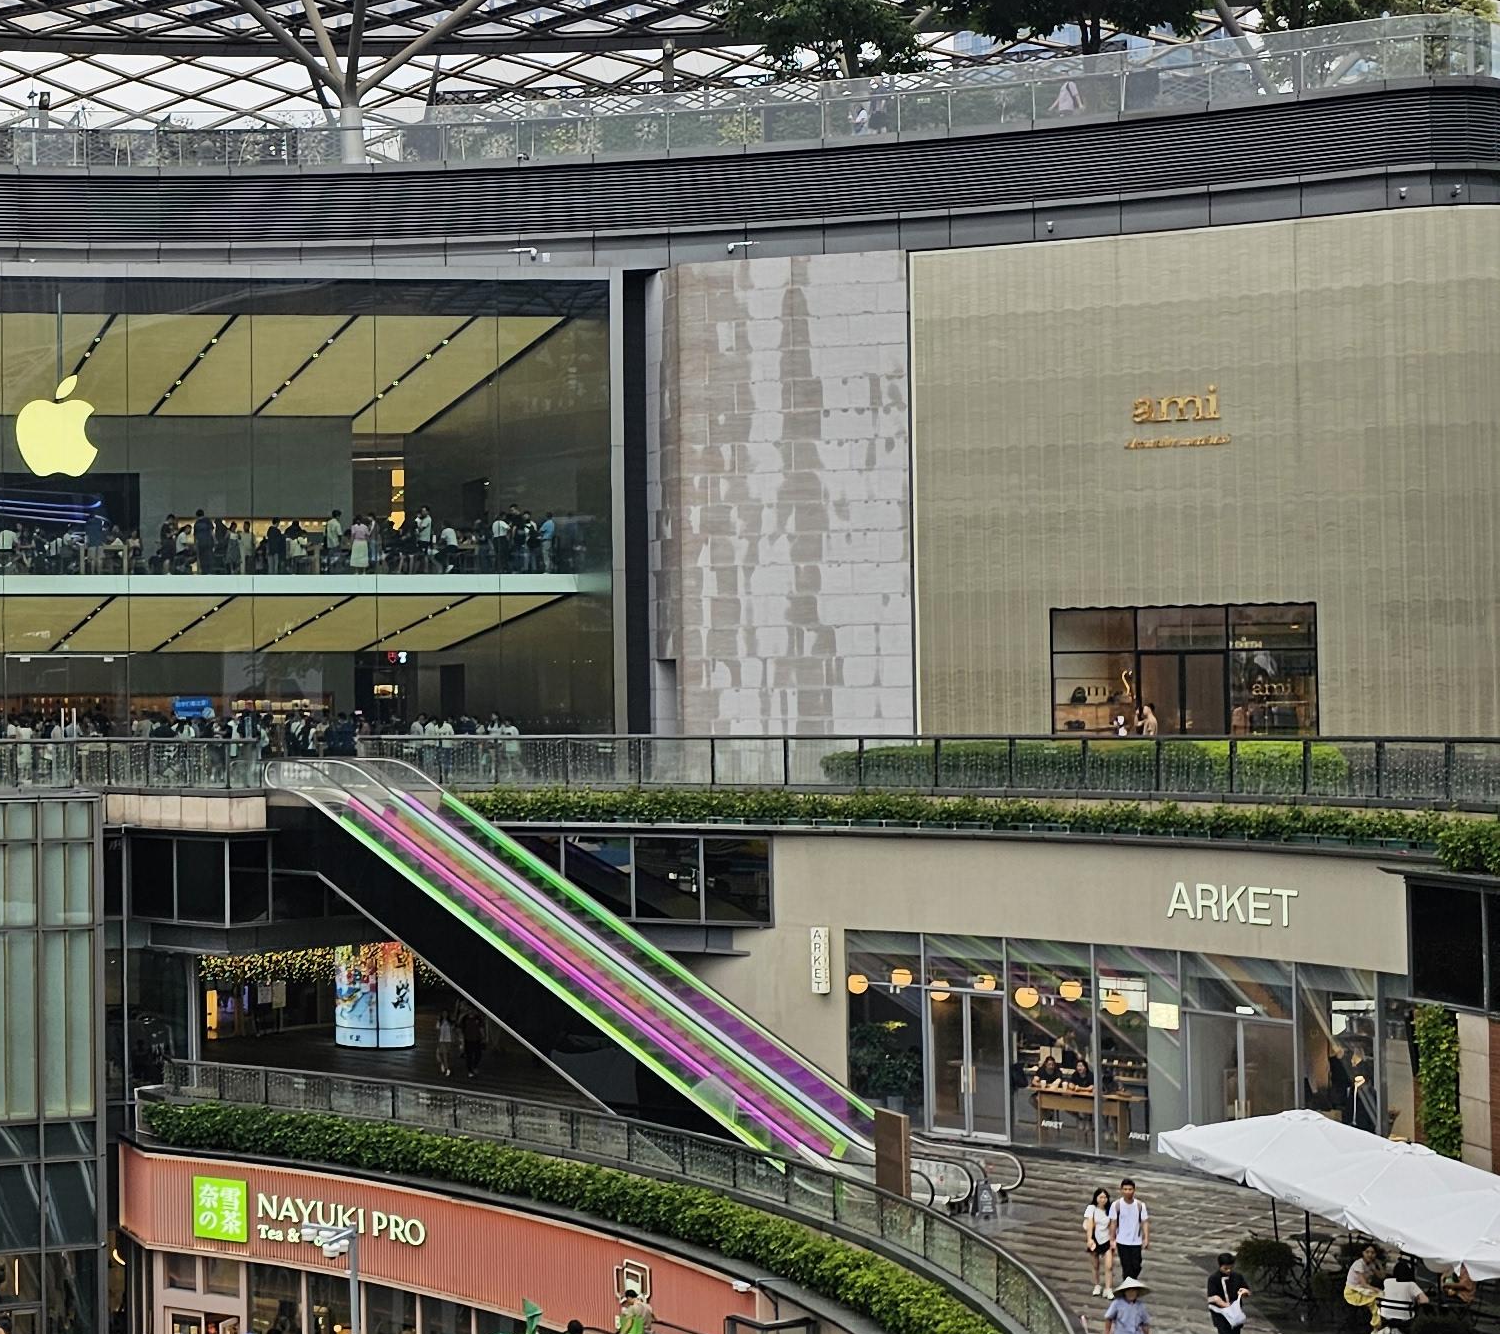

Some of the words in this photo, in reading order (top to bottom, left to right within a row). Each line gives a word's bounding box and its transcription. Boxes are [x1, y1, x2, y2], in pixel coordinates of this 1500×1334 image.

[1132, 385, 1221, 424] ami
[1166, 881, 1300, 928] ARKET
[813, 929, 823, 992] ARKET
[257, 1192, 366, 1235] NAYUKI
[372, 1210, 426, 1246] PRO
[257, 1223, 284, 1242] Tea
[287, 1227, 301, 1244] &
